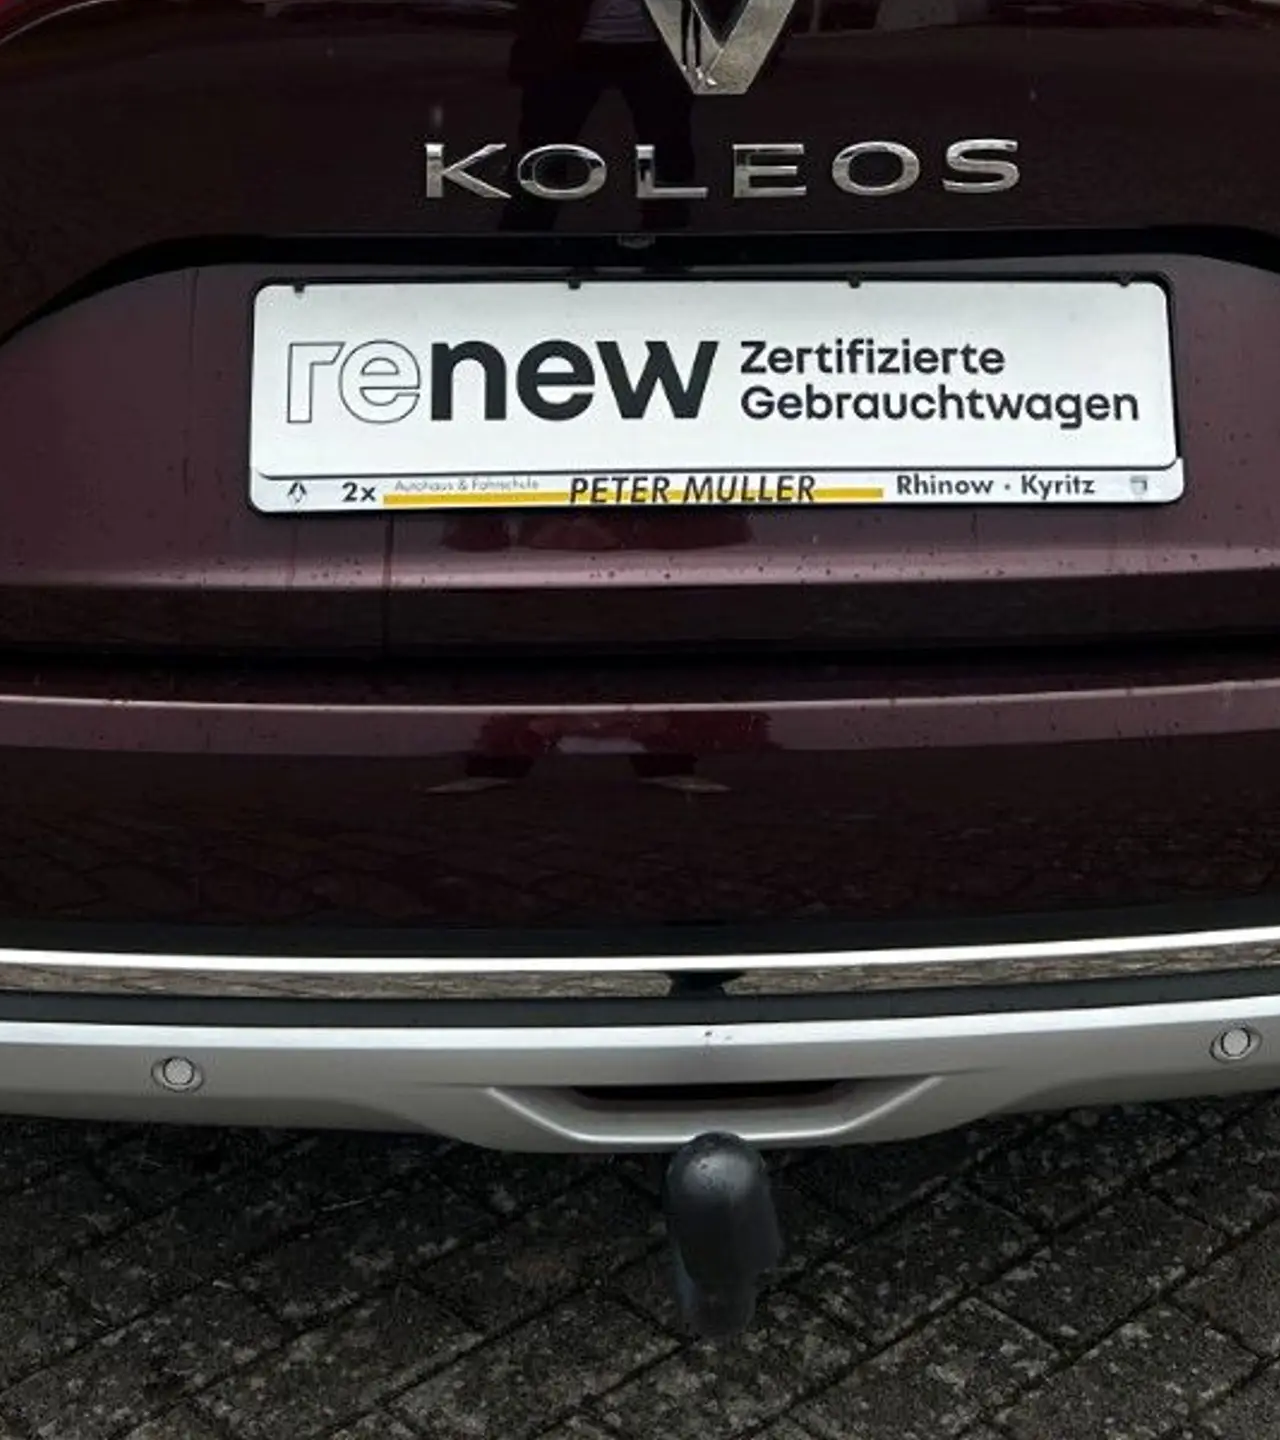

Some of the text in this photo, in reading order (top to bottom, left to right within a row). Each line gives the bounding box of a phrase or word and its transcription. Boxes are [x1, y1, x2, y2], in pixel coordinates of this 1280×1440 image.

[423, 138, 1021, 201] KOLEOS
[740, 337, 1006, 375] Zertifizierte
[286, 339, 719, 424] renew
[740, 384, 1140, 429] Gebrauchtwagen
[342, 482, 377, 503] 2x
[569, 476, 671, 504] PETER
[896, 473, 994, 496] Rhinow
[1021, 473, 1096, 500] Kyritz
